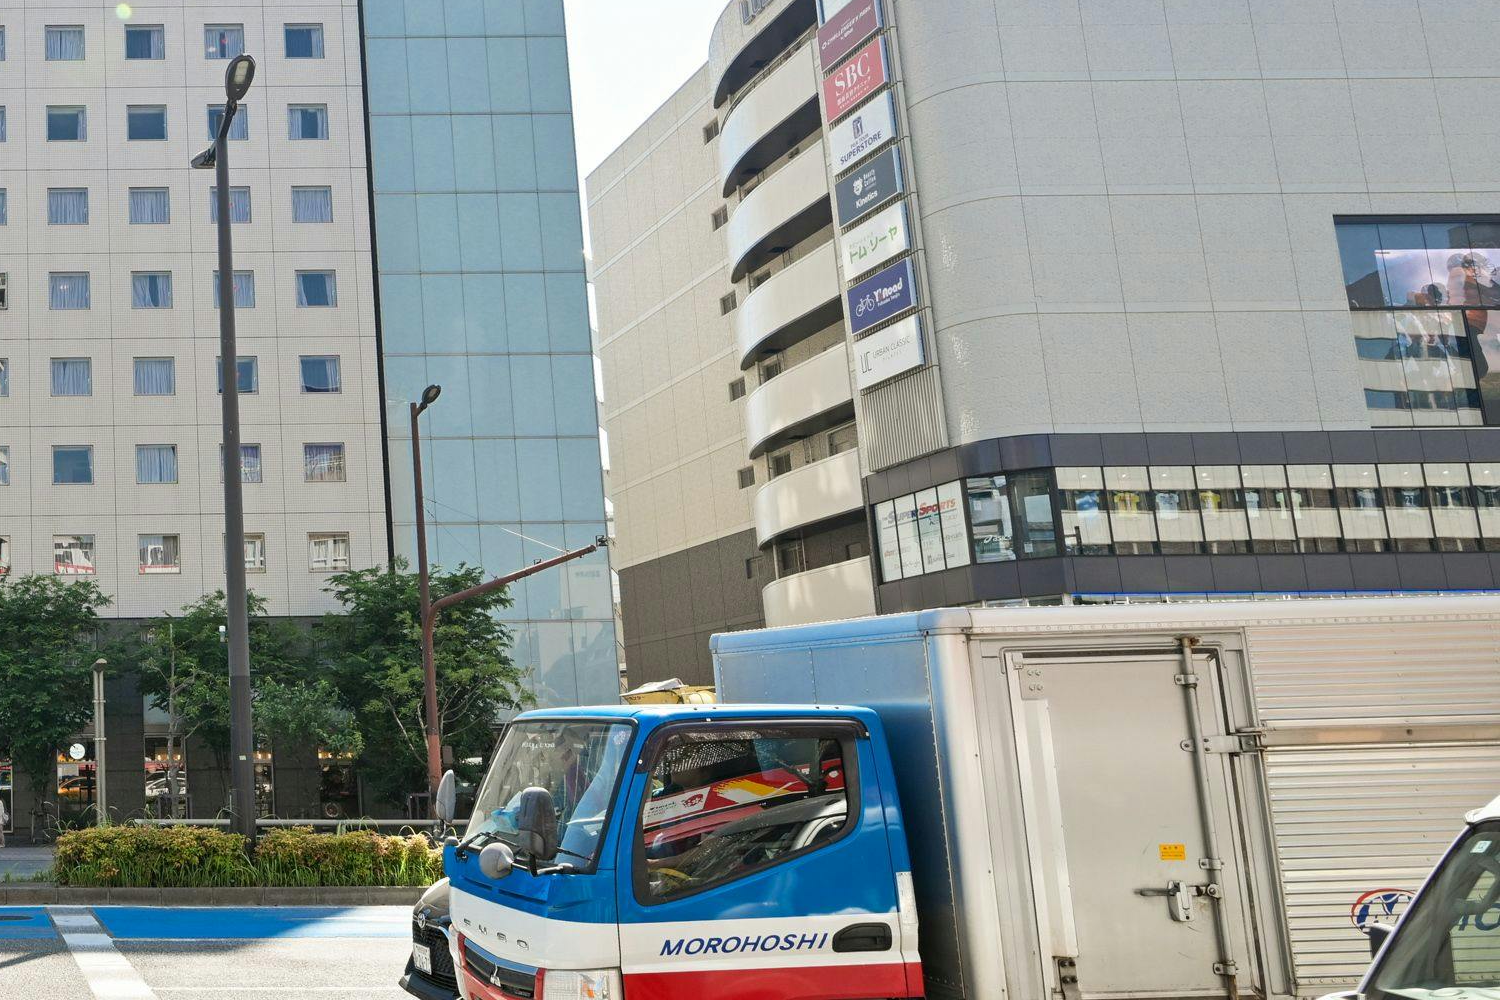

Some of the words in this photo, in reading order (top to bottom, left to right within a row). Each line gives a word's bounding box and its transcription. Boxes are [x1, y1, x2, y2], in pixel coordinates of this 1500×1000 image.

[835, 52, 870, 97] SBC
[840, 130, 883, 166] SUPERSTORE
[855, 189, 878, 209] Kinetics
[659, 932, 829, 957] MOROHOSHI
